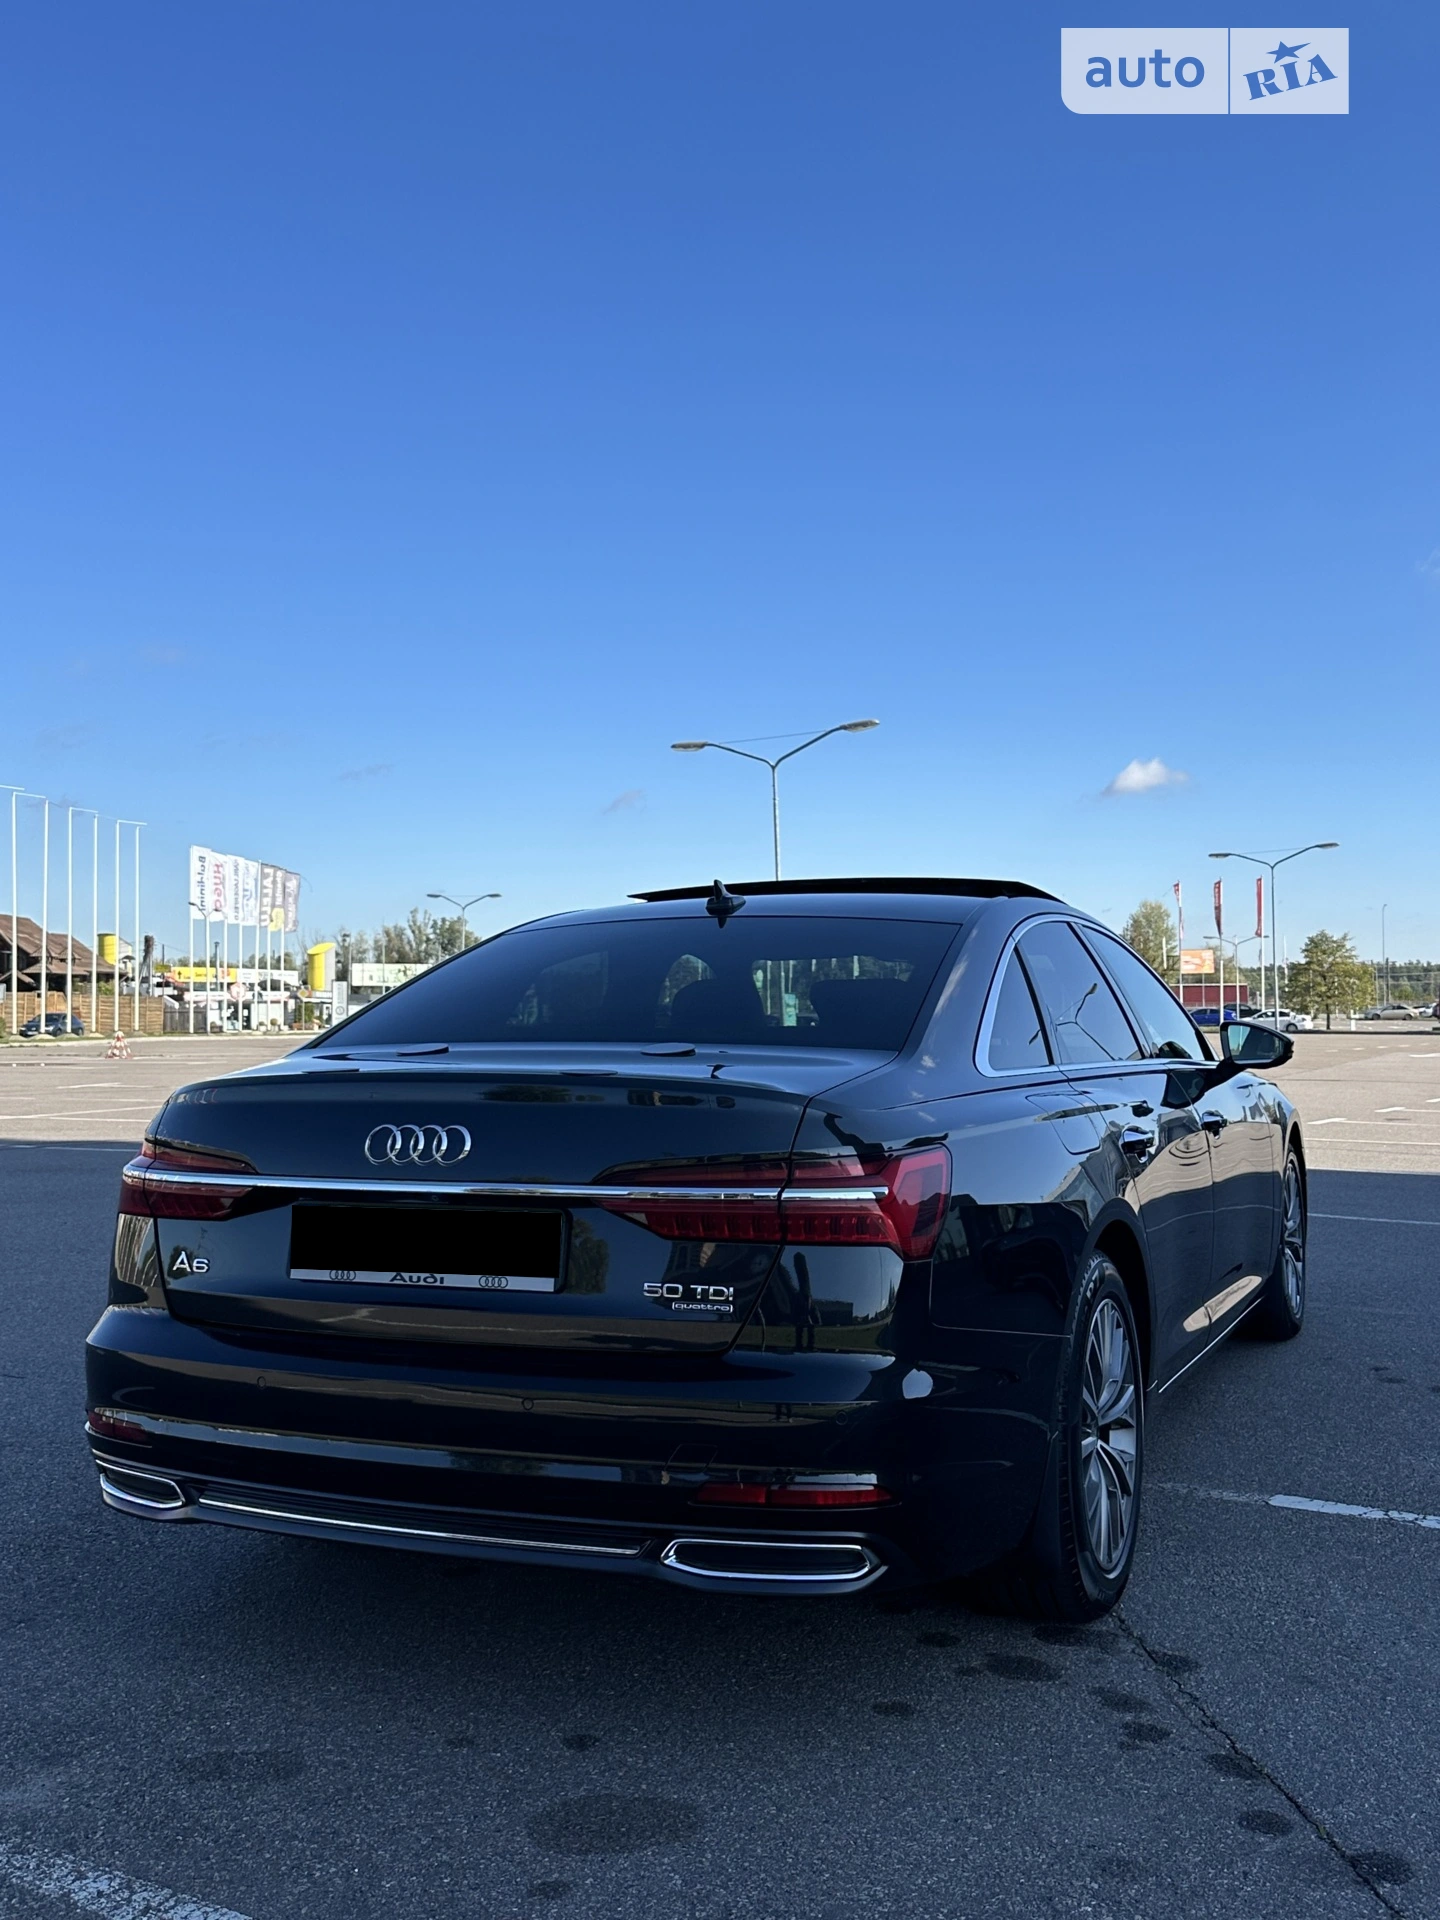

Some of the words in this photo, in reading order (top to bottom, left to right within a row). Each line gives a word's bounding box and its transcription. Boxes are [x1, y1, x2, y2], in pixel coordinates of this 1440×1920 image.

[172, 1250, 209, 1273] A6
[389, 1272, 445, 1285] Audi
[643, 1282, 683, 1298] 50
[690, 1285, 734, 1301] TDI
[674, 1302, 731, 1312] quattro
